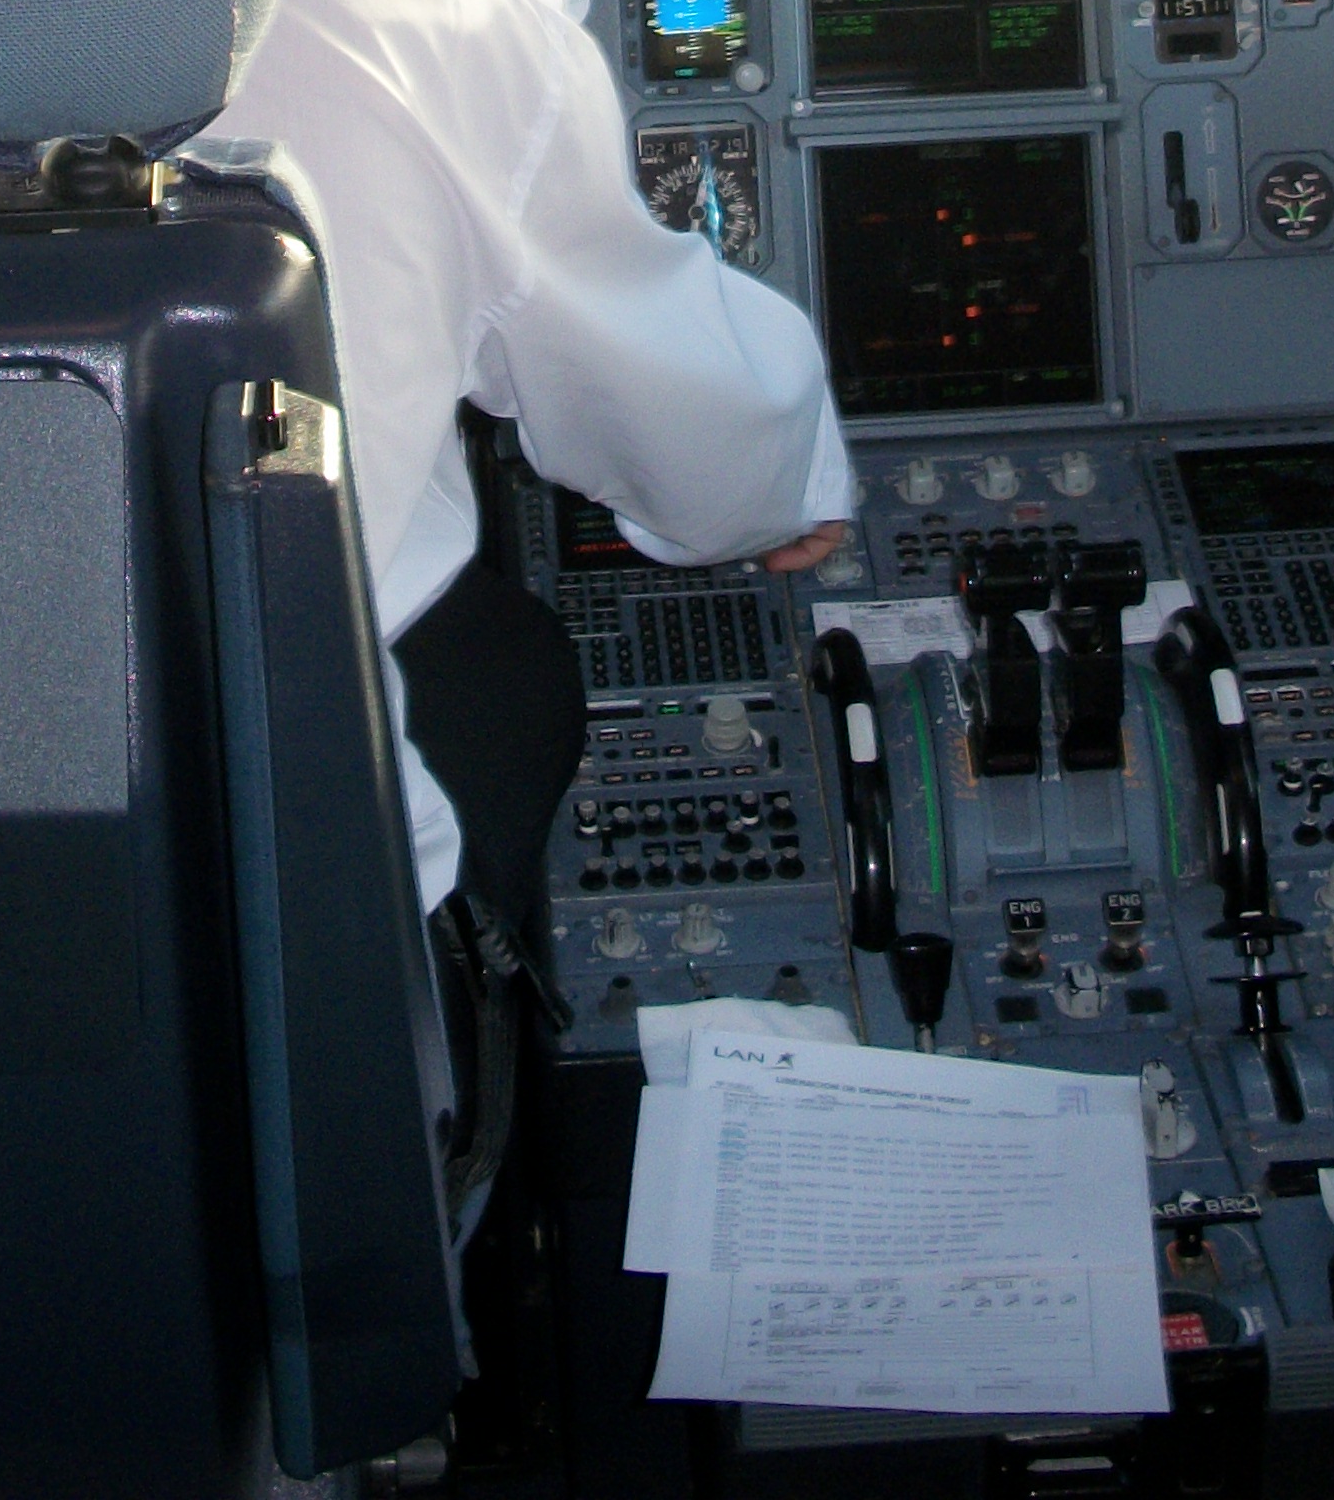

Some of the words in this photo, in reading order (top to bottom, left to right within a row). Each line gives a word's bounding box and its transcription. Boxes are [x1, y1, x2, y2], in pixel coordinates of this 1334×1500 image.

[1108, 893, 1141, 907] ENG
[1009, 901, 1042, 915] ENG
[1121, 908, 1130, 920] 2
[1023, 916, 1031, 928] 1
[1051, 933, 1080, 944] ENG
[713, 1046, 766, 1063] LAN
[1150, 1200, 1197, 1217] ARK
[1205, 1196, 1248, 1213] BRK
